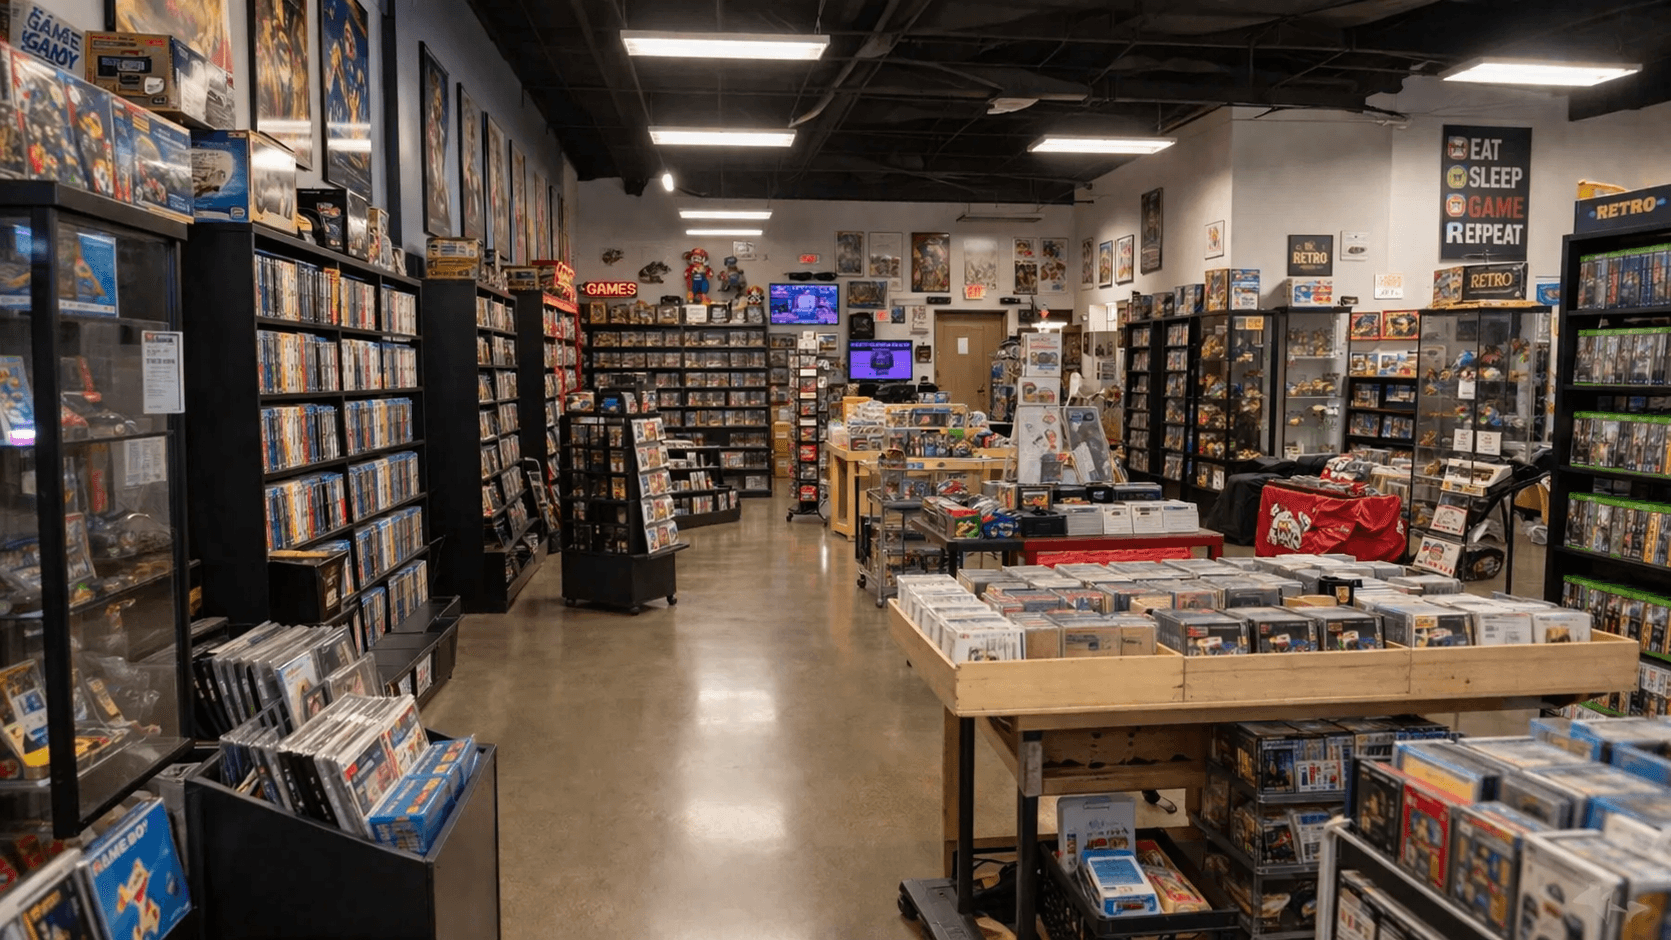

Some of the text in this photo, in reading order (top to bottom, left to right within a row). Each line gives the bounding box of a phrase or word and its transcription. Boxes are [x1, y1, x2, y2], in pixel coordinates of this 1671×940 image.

[1470, 138, 1503, 161] EAT
[1469, 166, 1523, 189] SLEEP
[1468, 195, 1524, 219] GAME
[1596, 196, 1657, 220] RETRO
[1293, 252, 1328, 264] RETRO
[586, 283, 637, 295] GAMES
[1471, 272, 1513, 289] RETRO
